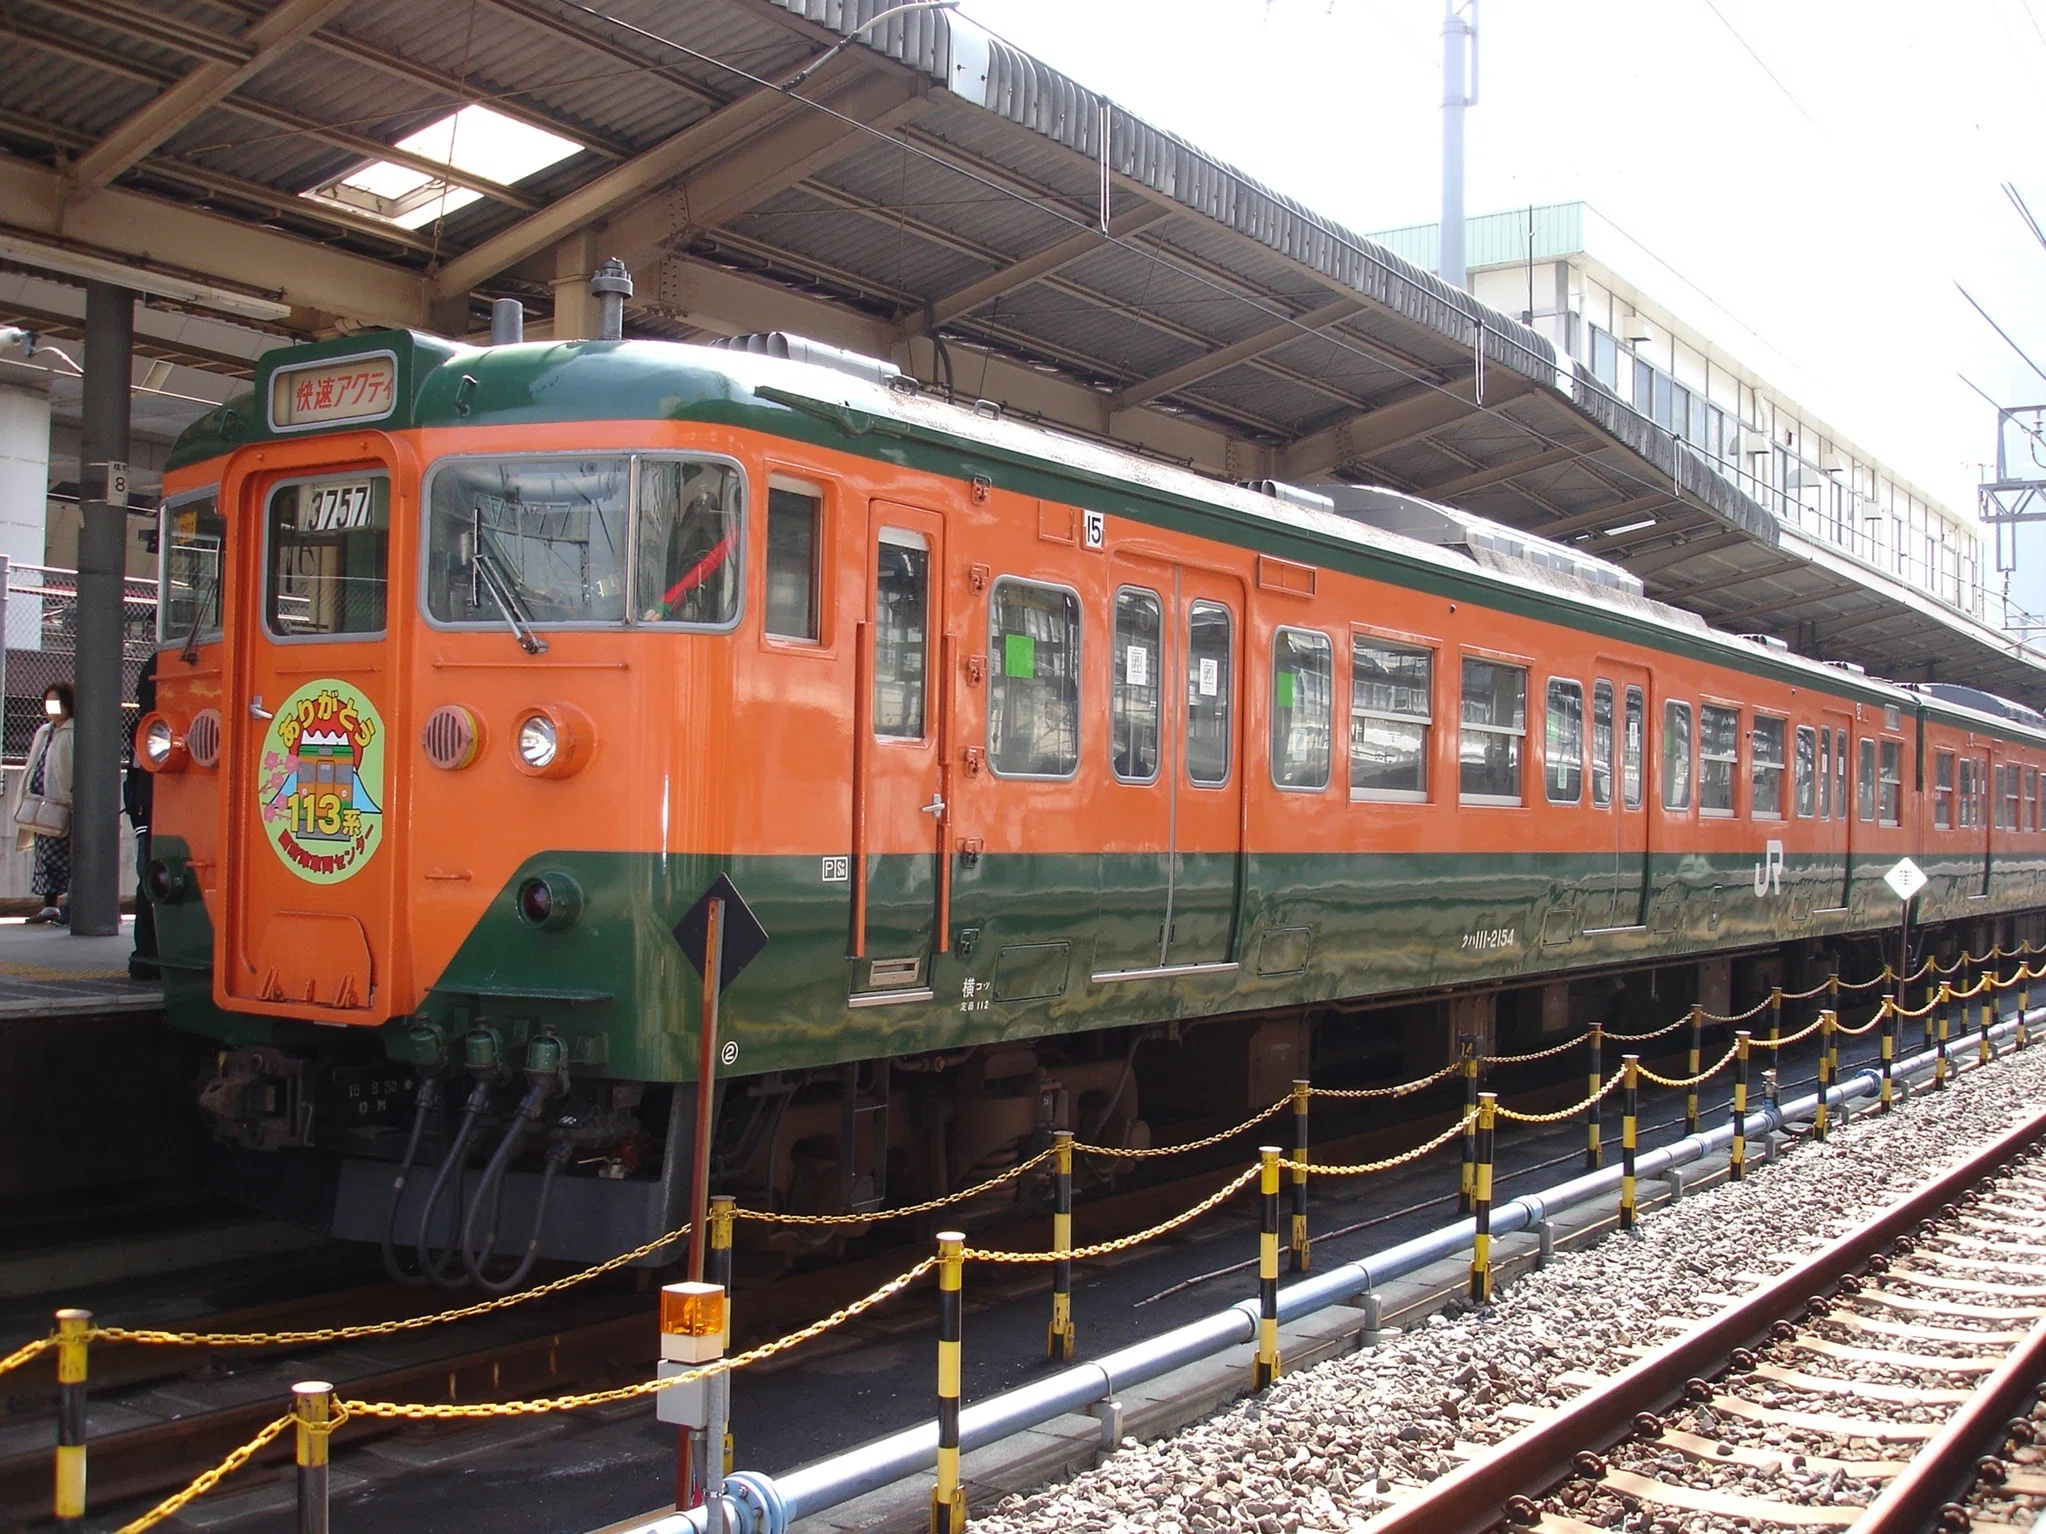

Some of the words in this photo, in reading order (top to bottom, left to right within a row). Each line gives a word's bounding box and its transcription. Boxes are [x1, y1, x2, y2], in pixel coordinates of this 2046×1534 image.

[296, 371, 393, 412] 快速アクティ
[115, 476, 125, 492] 8
[308, 486, 369, 530] 3757
[1087, 515, 1101, 544] 15
[277, 689, 376, 748] ありがとう
[287, 792, 361, 836] 113系
[1754, 839, 1783, 897] JR
[976, 1000, 989, 1010] 112
